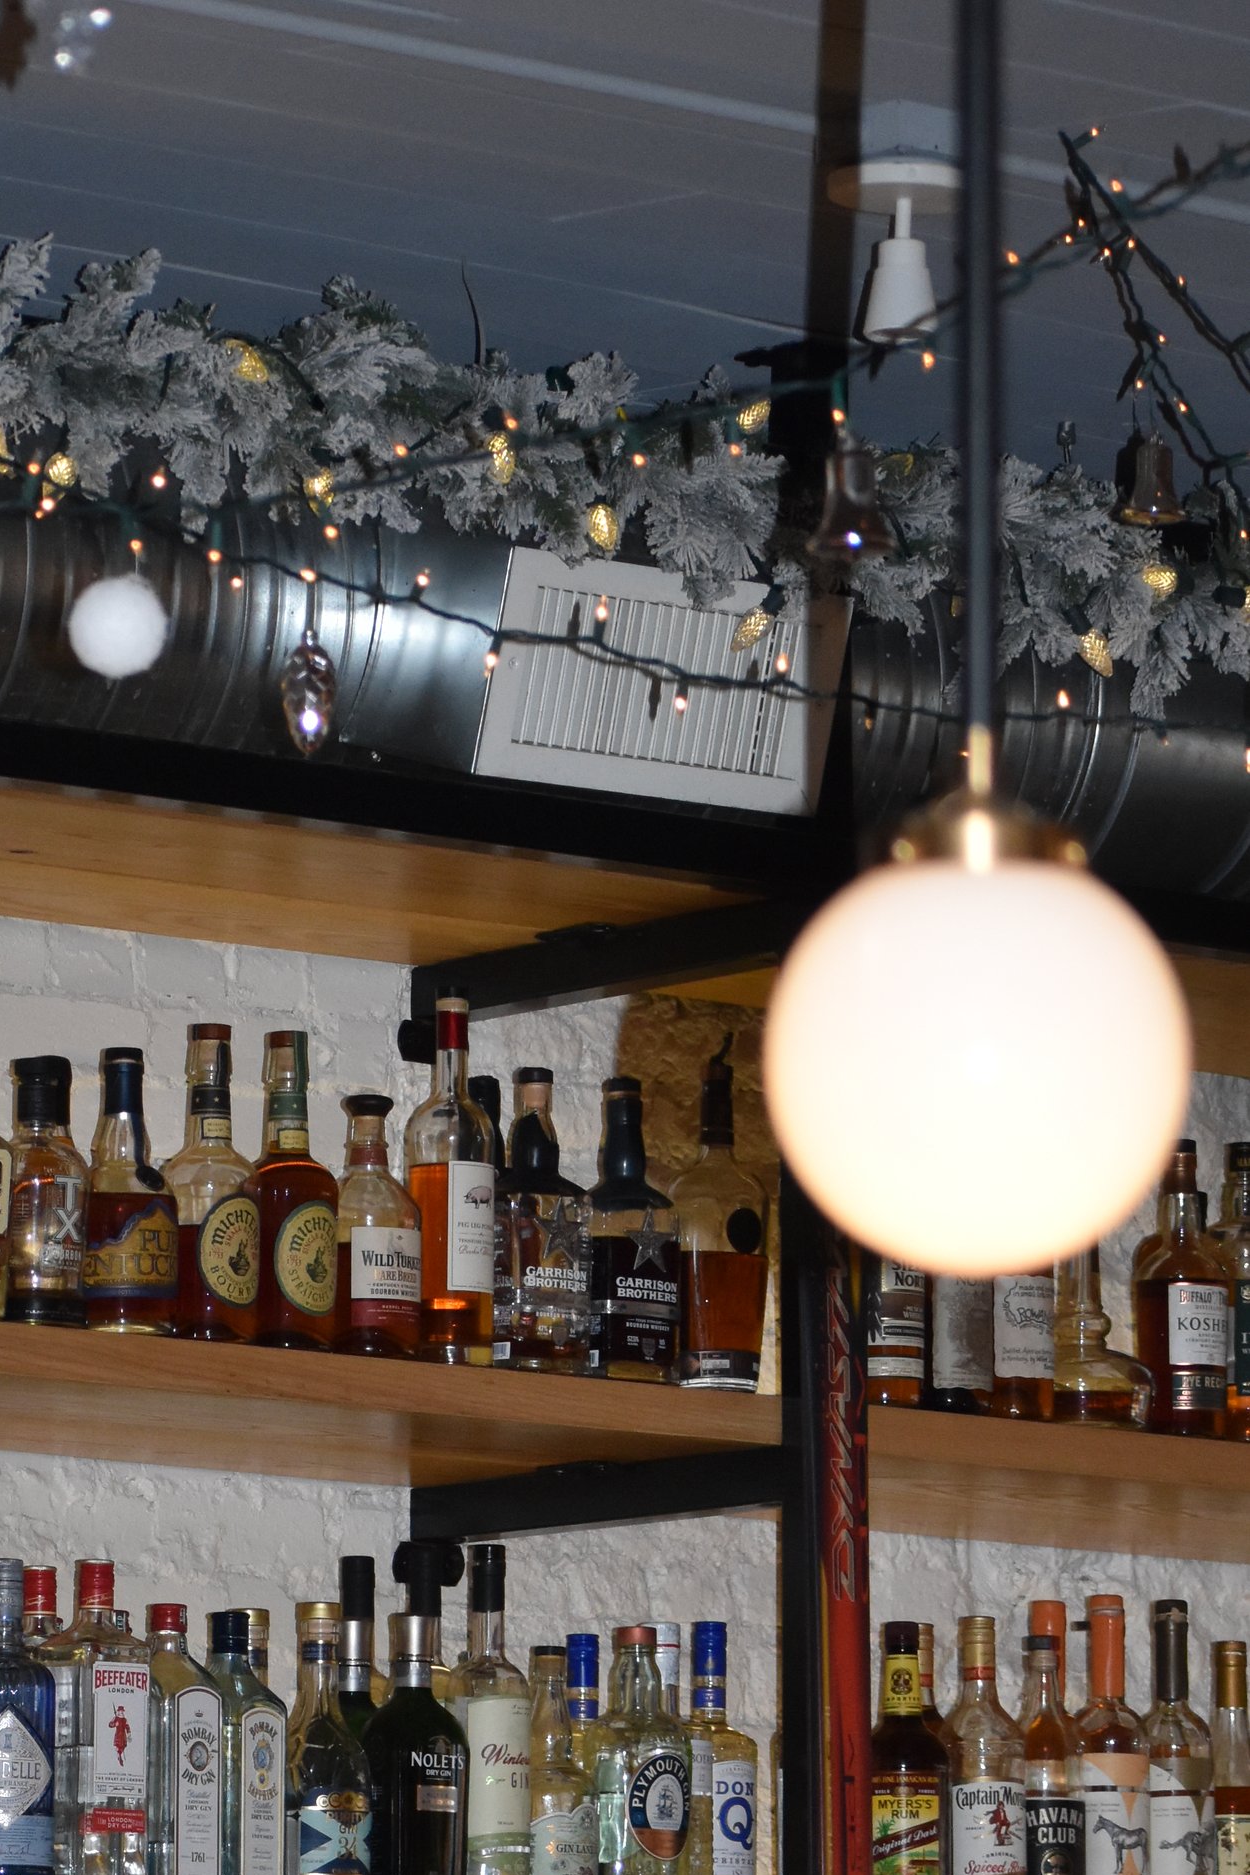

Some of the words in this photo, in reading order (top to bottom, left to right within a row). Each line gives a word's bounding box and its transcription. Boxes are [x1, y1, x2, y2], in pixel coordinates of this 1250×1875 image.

[362, 1250, 394, 1267] WILD
[526, 1266, 587, 1281] GARRISON
[370, 1288, 400, 1296] BOURBON
[528, 1276, 588, 1292] BROTHERS
[616, 1276, 678, 1292] GARRISON
[616, 1287, 678, 1304] BROTHERS
[1180, 1290, 1212, 1304] BUFFALO
[626, 1322, 650, 1330] BOURBON
[650, 1324, 670, 1332] WHISKEY
[1182, 1376, 1202, 1388] RYE
[94, 1670, 148, 1692] BEEFEATER
[180, 1727, 218, 1746] BOMBAY
[248, 1722, 278, 1742] BOMBAY
[411, 1752, 464, 1770] NOLET'S
[182, 1768, 200, 1786] DRY
[200, 1770, 216, 1785] GIN
[632, 1758, 685, 1808] PLYMOUTH
[248, 1782, 278, 1802] SAPPHIRE
[716, 1781, 754, 1796] DON
[878, 1798, 932, 1810] MYERS'S
[956, 1786, 1000, 1810] Captain
[891, 1808, 920, 1820] RUM
[1026, 1807, 1084, 1827] HAVANA
[339, 1824, 358, 1834] GIN
[719, 1796, 754, 1850] Q
[872, 1834, 912, 1856] Original
[914, 1827, 938, 1842] Dark
[1037, 1828, 1076, 1844] CLUB
[338, 1840, 356, 1860] 34
[556, 1844, 574, 1853] GIN
[191, 1852, 206, 1863] 1761
[964, 1860, 1007, 1875] Spiced
